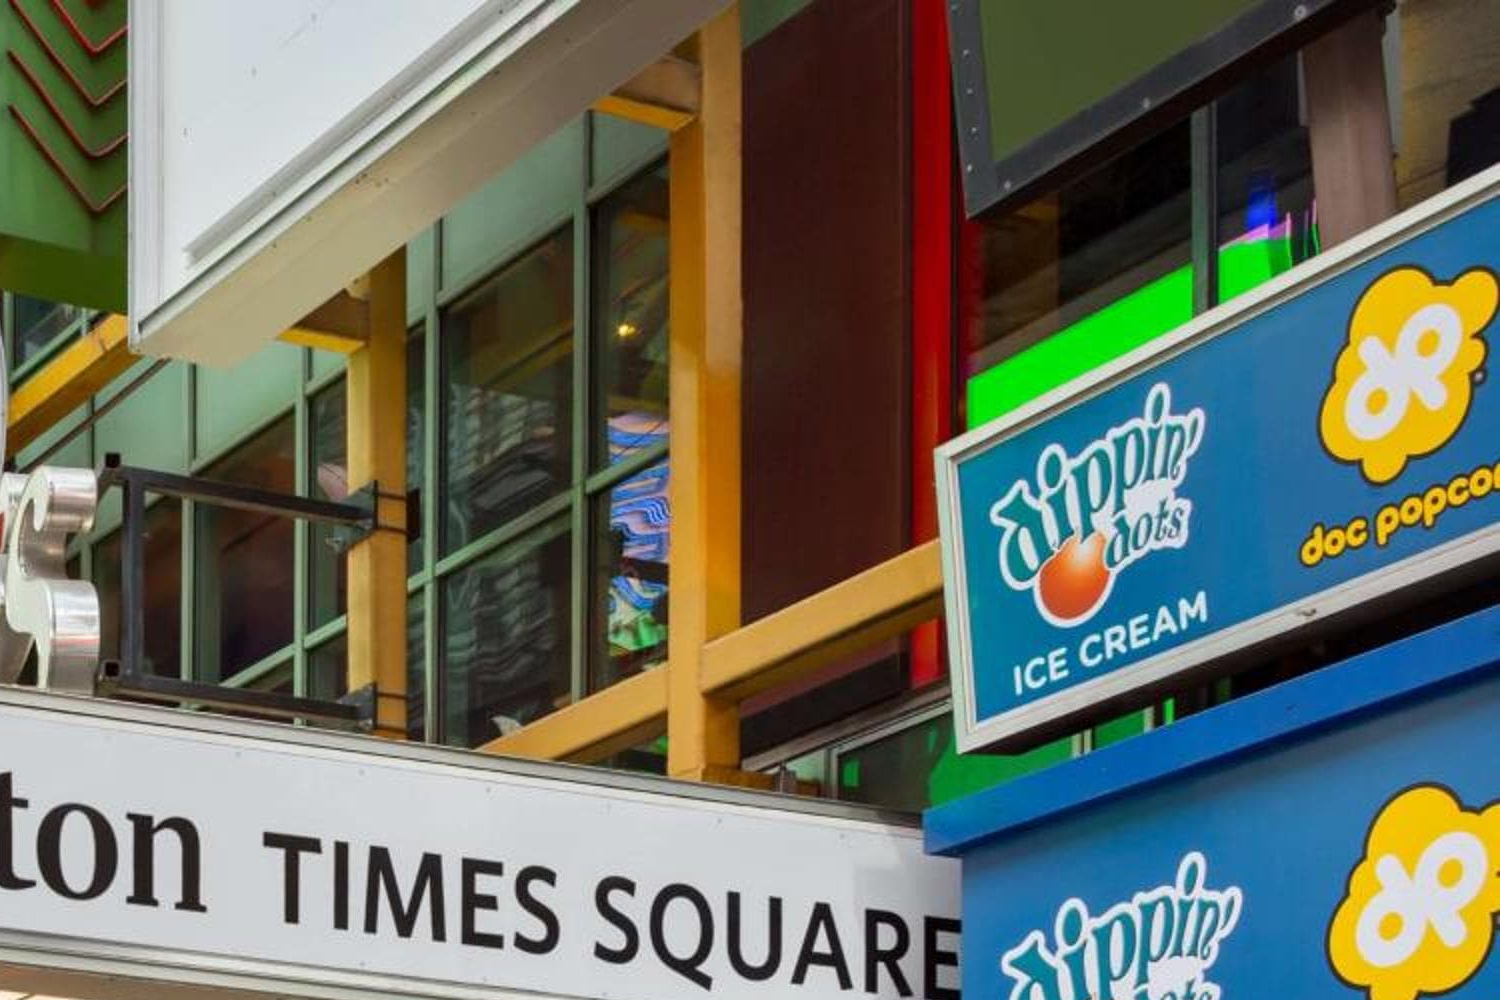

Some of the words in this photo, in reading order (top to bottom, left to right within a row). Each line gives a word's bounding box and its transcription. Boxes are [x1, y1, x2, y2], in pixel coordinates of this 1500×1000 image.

[1105, 499, 1191, 570] dots
[1300, 525, 1369, 567] doc
[1013, 648, 1069, 695] ICE
[1078, 591, 1208, 664] CREAM
[262, 830, 562, 956] TIMES
